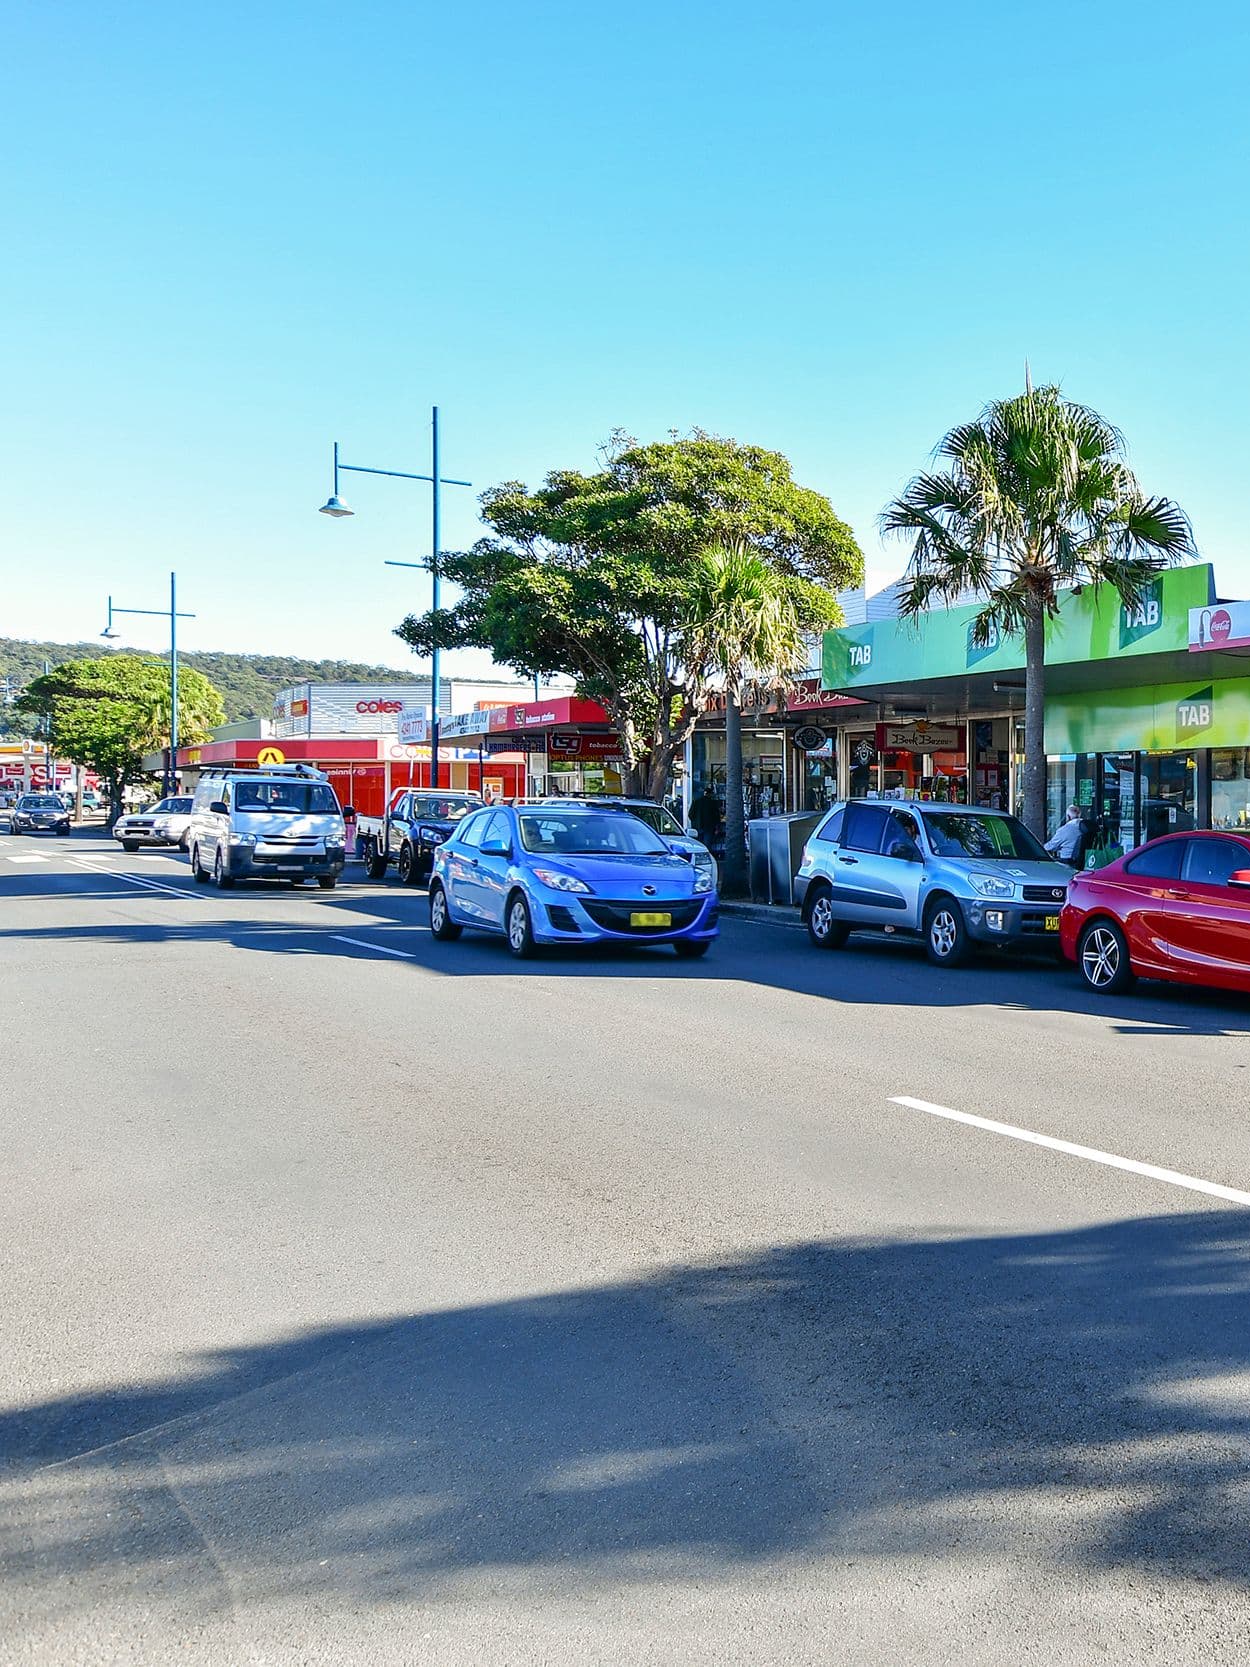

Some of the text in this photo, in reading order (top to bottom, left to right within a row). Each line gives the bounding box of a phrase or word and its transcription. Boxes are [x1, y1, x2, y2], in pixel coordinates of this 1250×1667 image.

[849, 645, 872, 666] TAB
[356, 697, 403, 714] coles
[1178, 704, 1210, 727] TAB
[550, 731, 582, 754] tsg
[891, 733, 918, 746] Book
